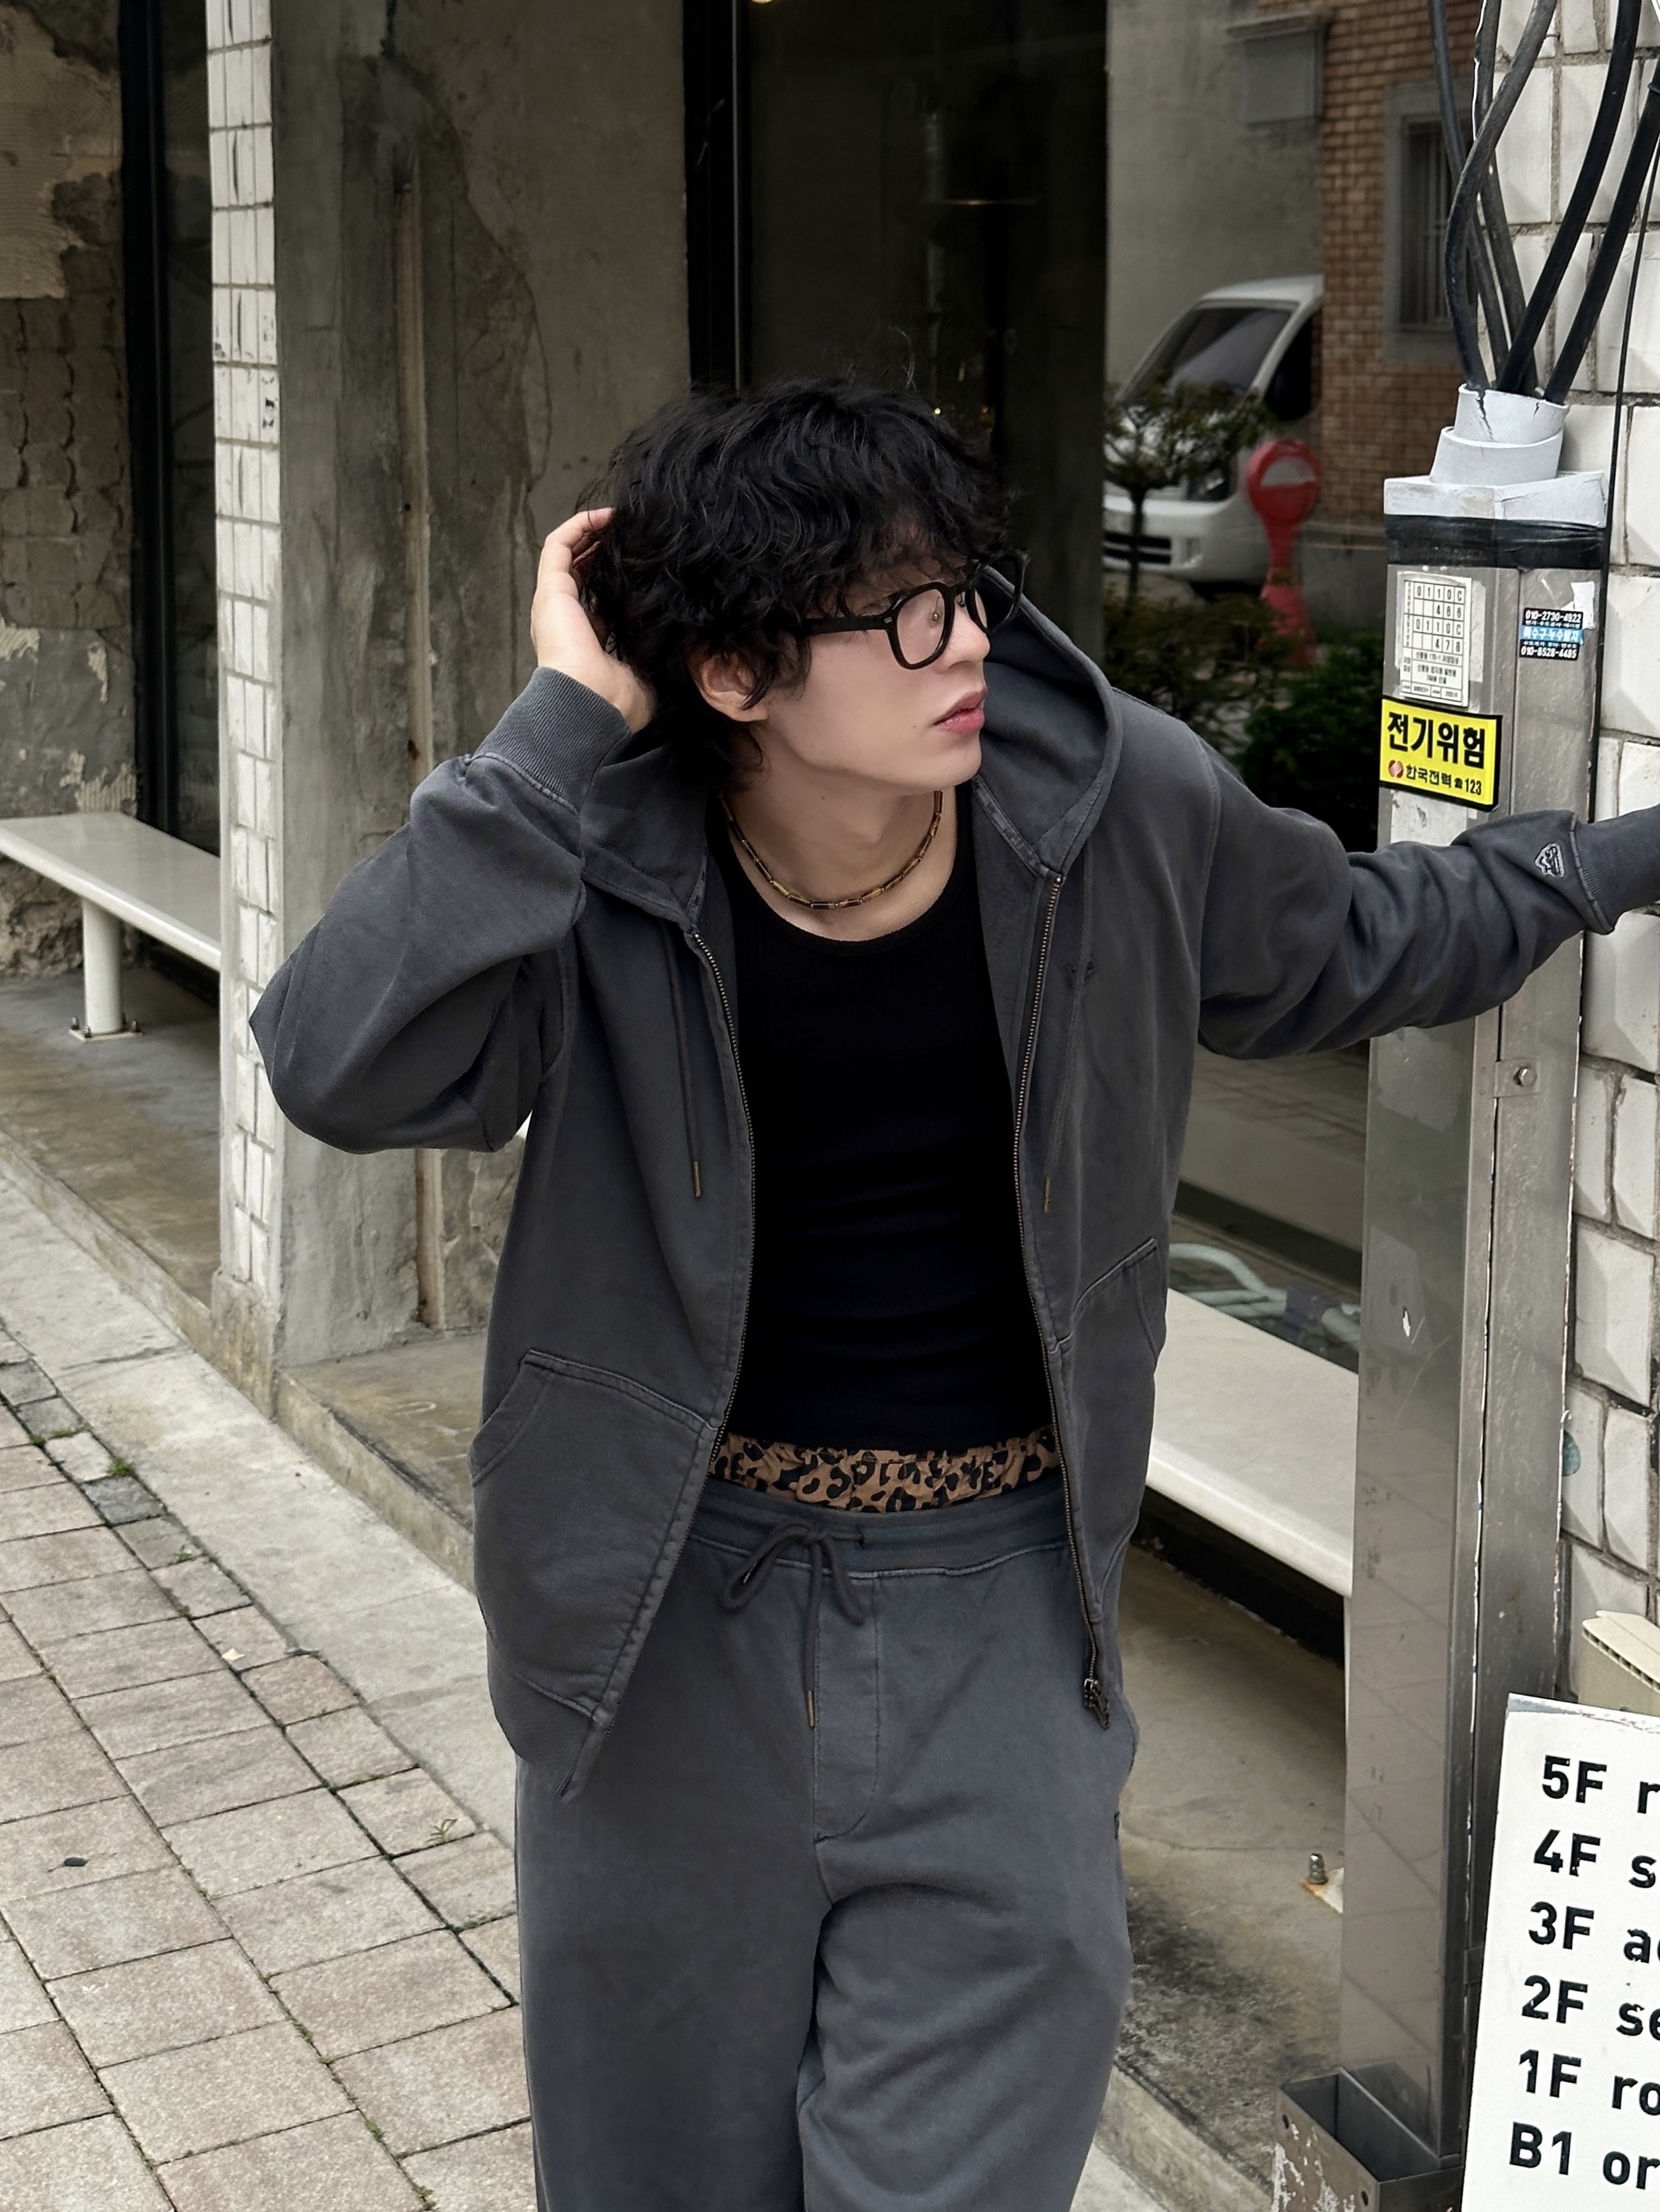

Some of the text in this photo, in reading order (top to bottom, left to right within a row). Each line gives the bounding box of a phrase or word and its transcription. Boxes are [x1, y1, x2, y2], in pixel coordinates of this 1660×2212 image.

[1387, 712, 1485, 769] 전기위험
[1405, 764, 1482, 796] 한국전력 123
[1542, 1754, 1607, 1803] 5F
[1534, 1829, 1657, 1888] 4F s
[1529, 1901, 1660, 1963] 3F a
[1522, 1975, 1588, 2023] 2F
[1519, 2049, 1660, 2116] 1F ro
[1510, 2121, 1660, 2190] B1 or
